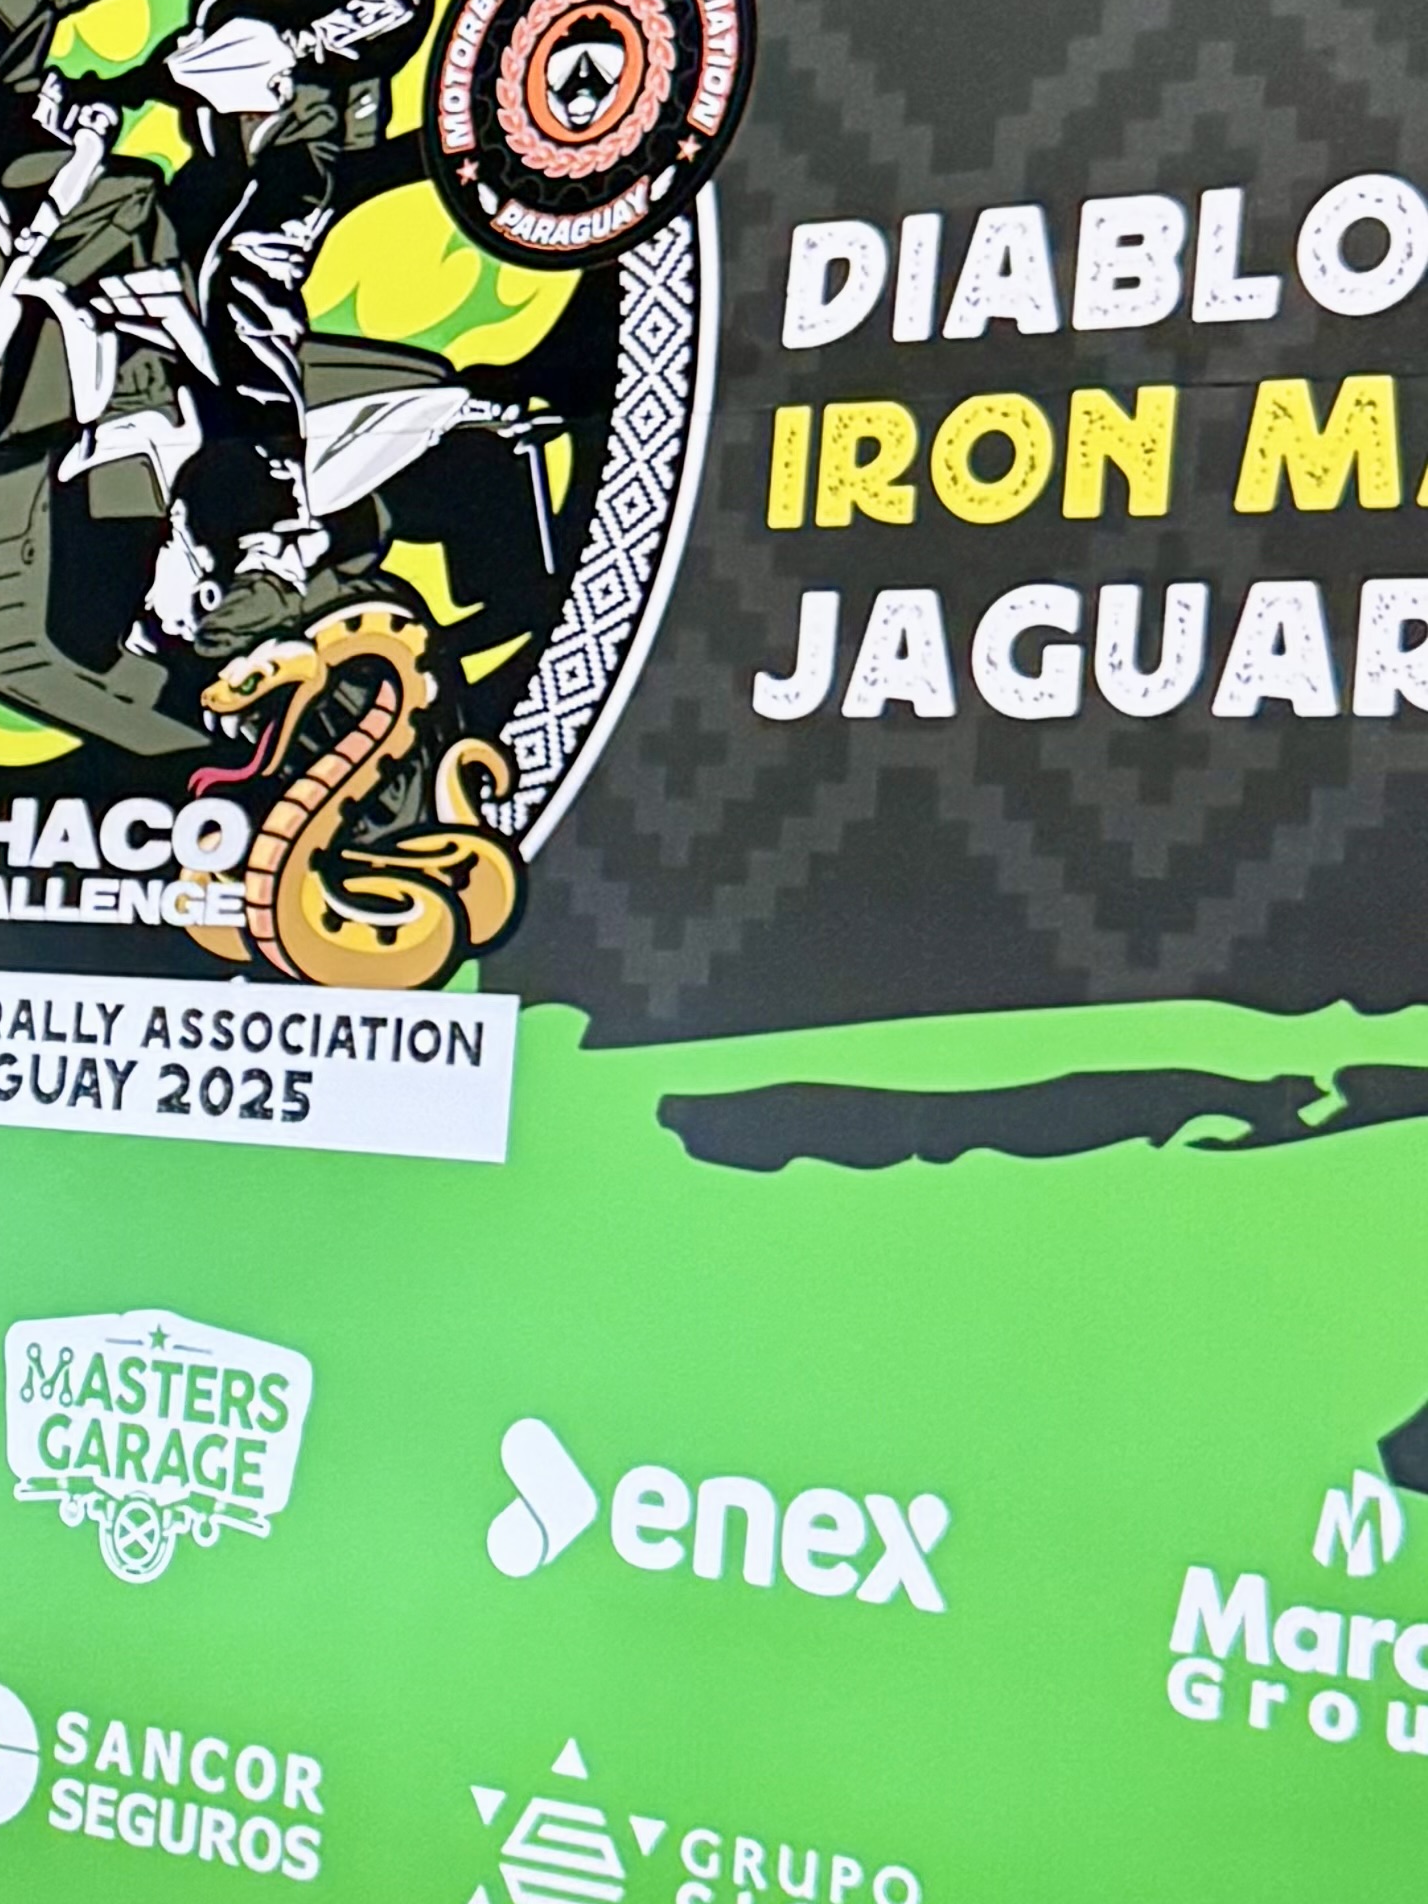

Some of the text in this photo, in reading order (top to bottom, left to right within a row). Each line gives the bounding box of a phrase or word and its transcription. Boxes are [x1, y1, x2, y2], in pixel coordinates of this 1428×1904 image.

[496, 183, 649, 246] PARAGUAY
[781, 173, 1428, 350] DIABLO
[767, 375, 1428, 529] IRON M
[752, 578, 1428, 720] JAGUAR
[141, 1006, 485, 1068] ASSOCIATION
[155, 1062, 315, 1124] 2025
[19, 1342, 290, 1434] MASTERS
[37, 1413, 268, 1500] GARAGE
[610, 1464, 951, 1614] enex
[54, 1711, 324, 1815] SANCOR
[48, 1777, 322, 1881] SEGUROS
